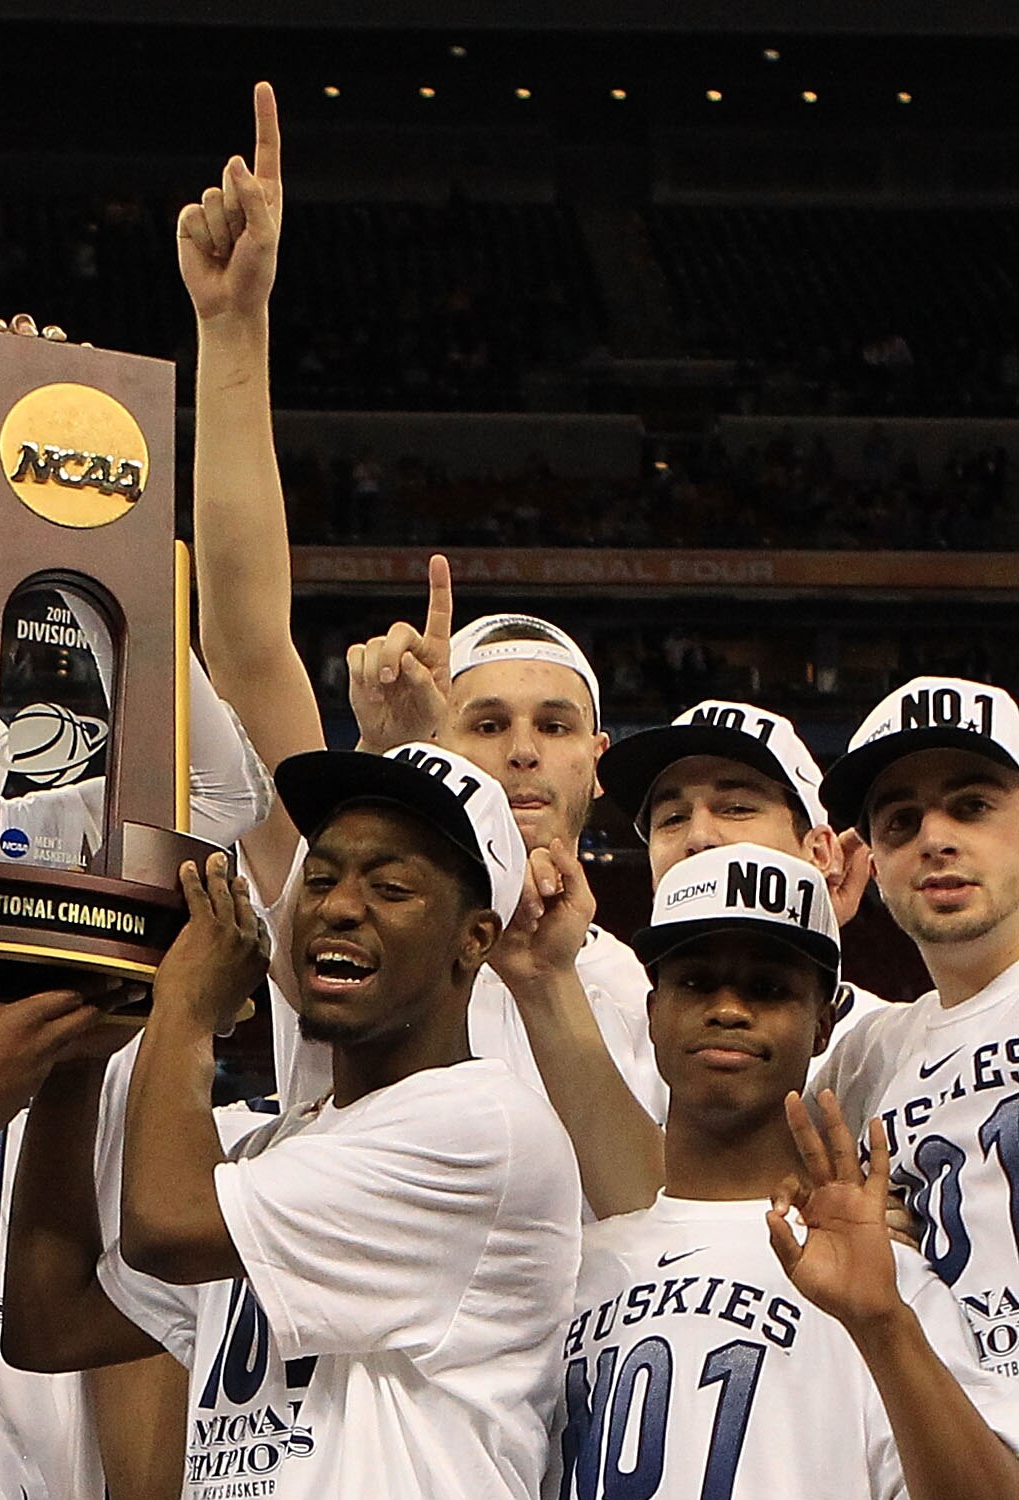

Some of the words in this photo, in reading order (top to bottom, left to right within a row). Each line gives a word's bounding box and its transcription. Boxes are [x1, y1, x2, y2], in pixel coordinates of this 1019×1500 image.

[11, 440, 143, 503] NCAA
[543, 561, 648, 580] FINAL
[670, 562, 774, 581] FOUR
[45, 605, 72, 625] 2011
[17, 618, 88, 650] DIVISION
[1, 840, 29, 853] NCAA
[33, 849, 88, 867] BASKETBALL
[666, 879, 718, 907] UCONN
[57, 901, 146, 936] CHAMPION
[563, 1273, 802, 1360] HUSKIES
